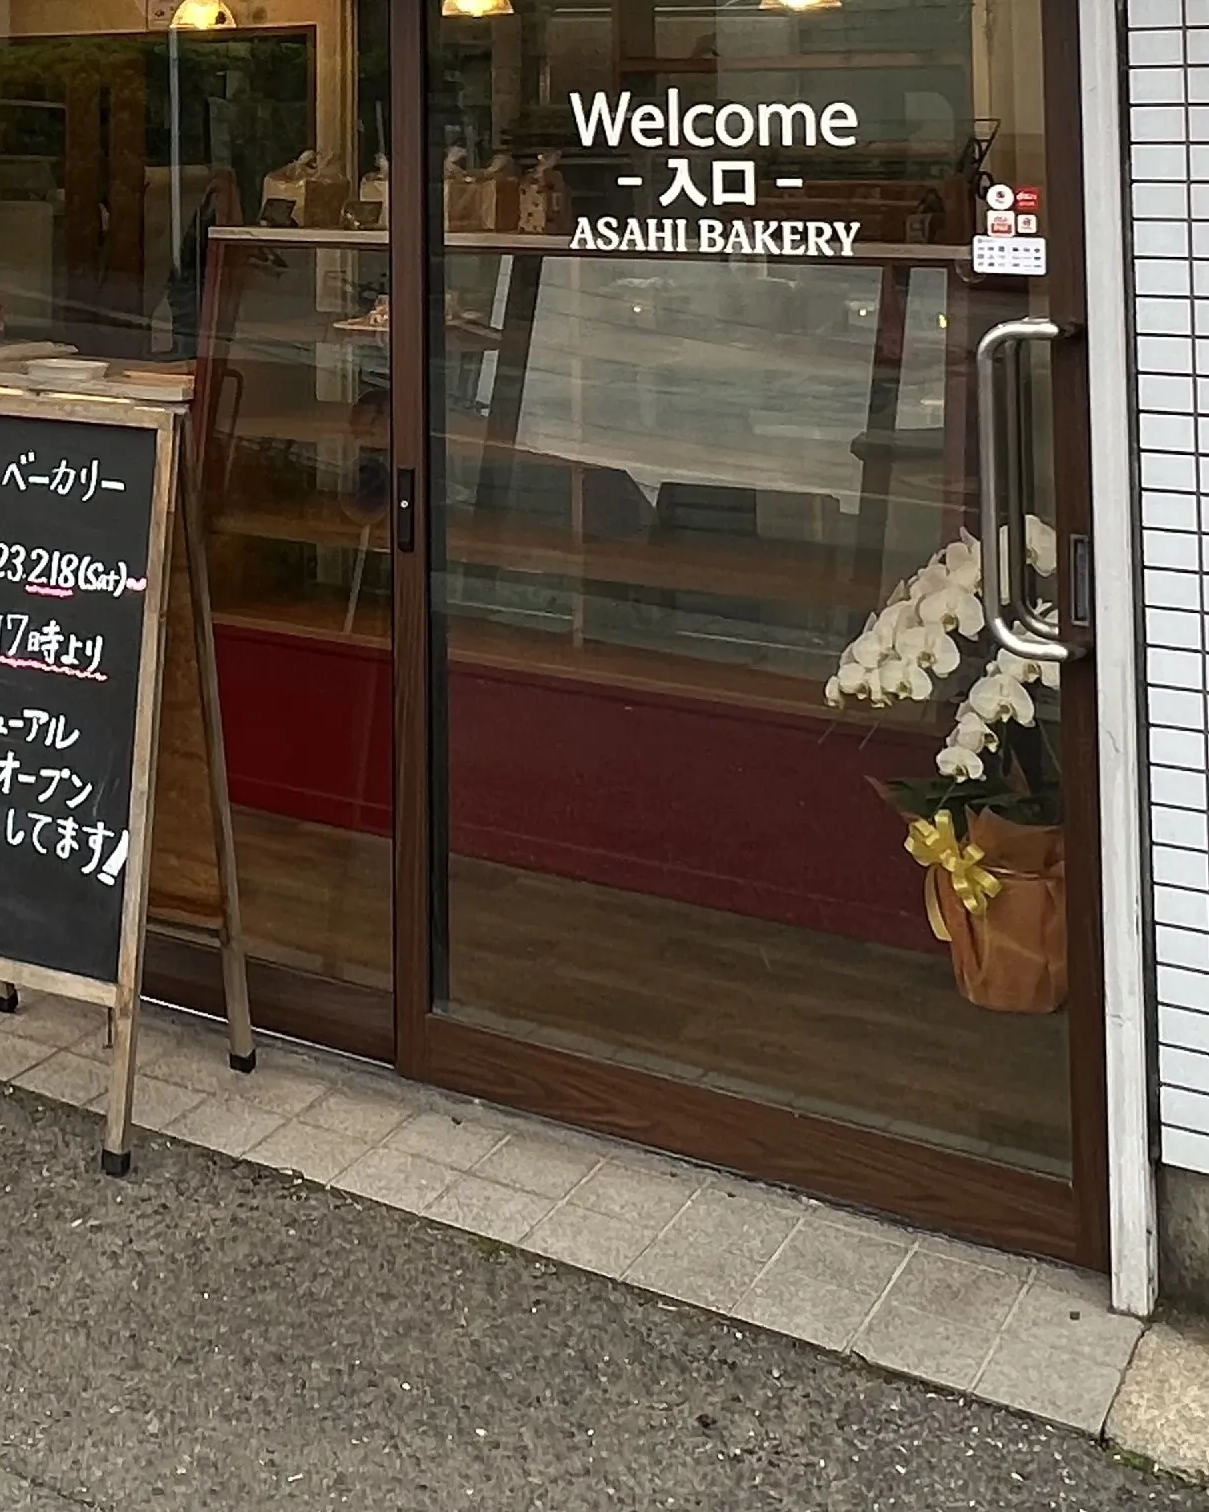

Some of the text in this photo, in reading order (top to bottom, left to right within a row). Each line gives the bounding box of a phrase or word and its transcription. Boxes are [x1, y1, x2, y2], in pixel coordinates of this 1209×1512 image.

[569, 88, 858, 147] Welcome
[569, 216, 861, 257] ASAHI BAKERY
